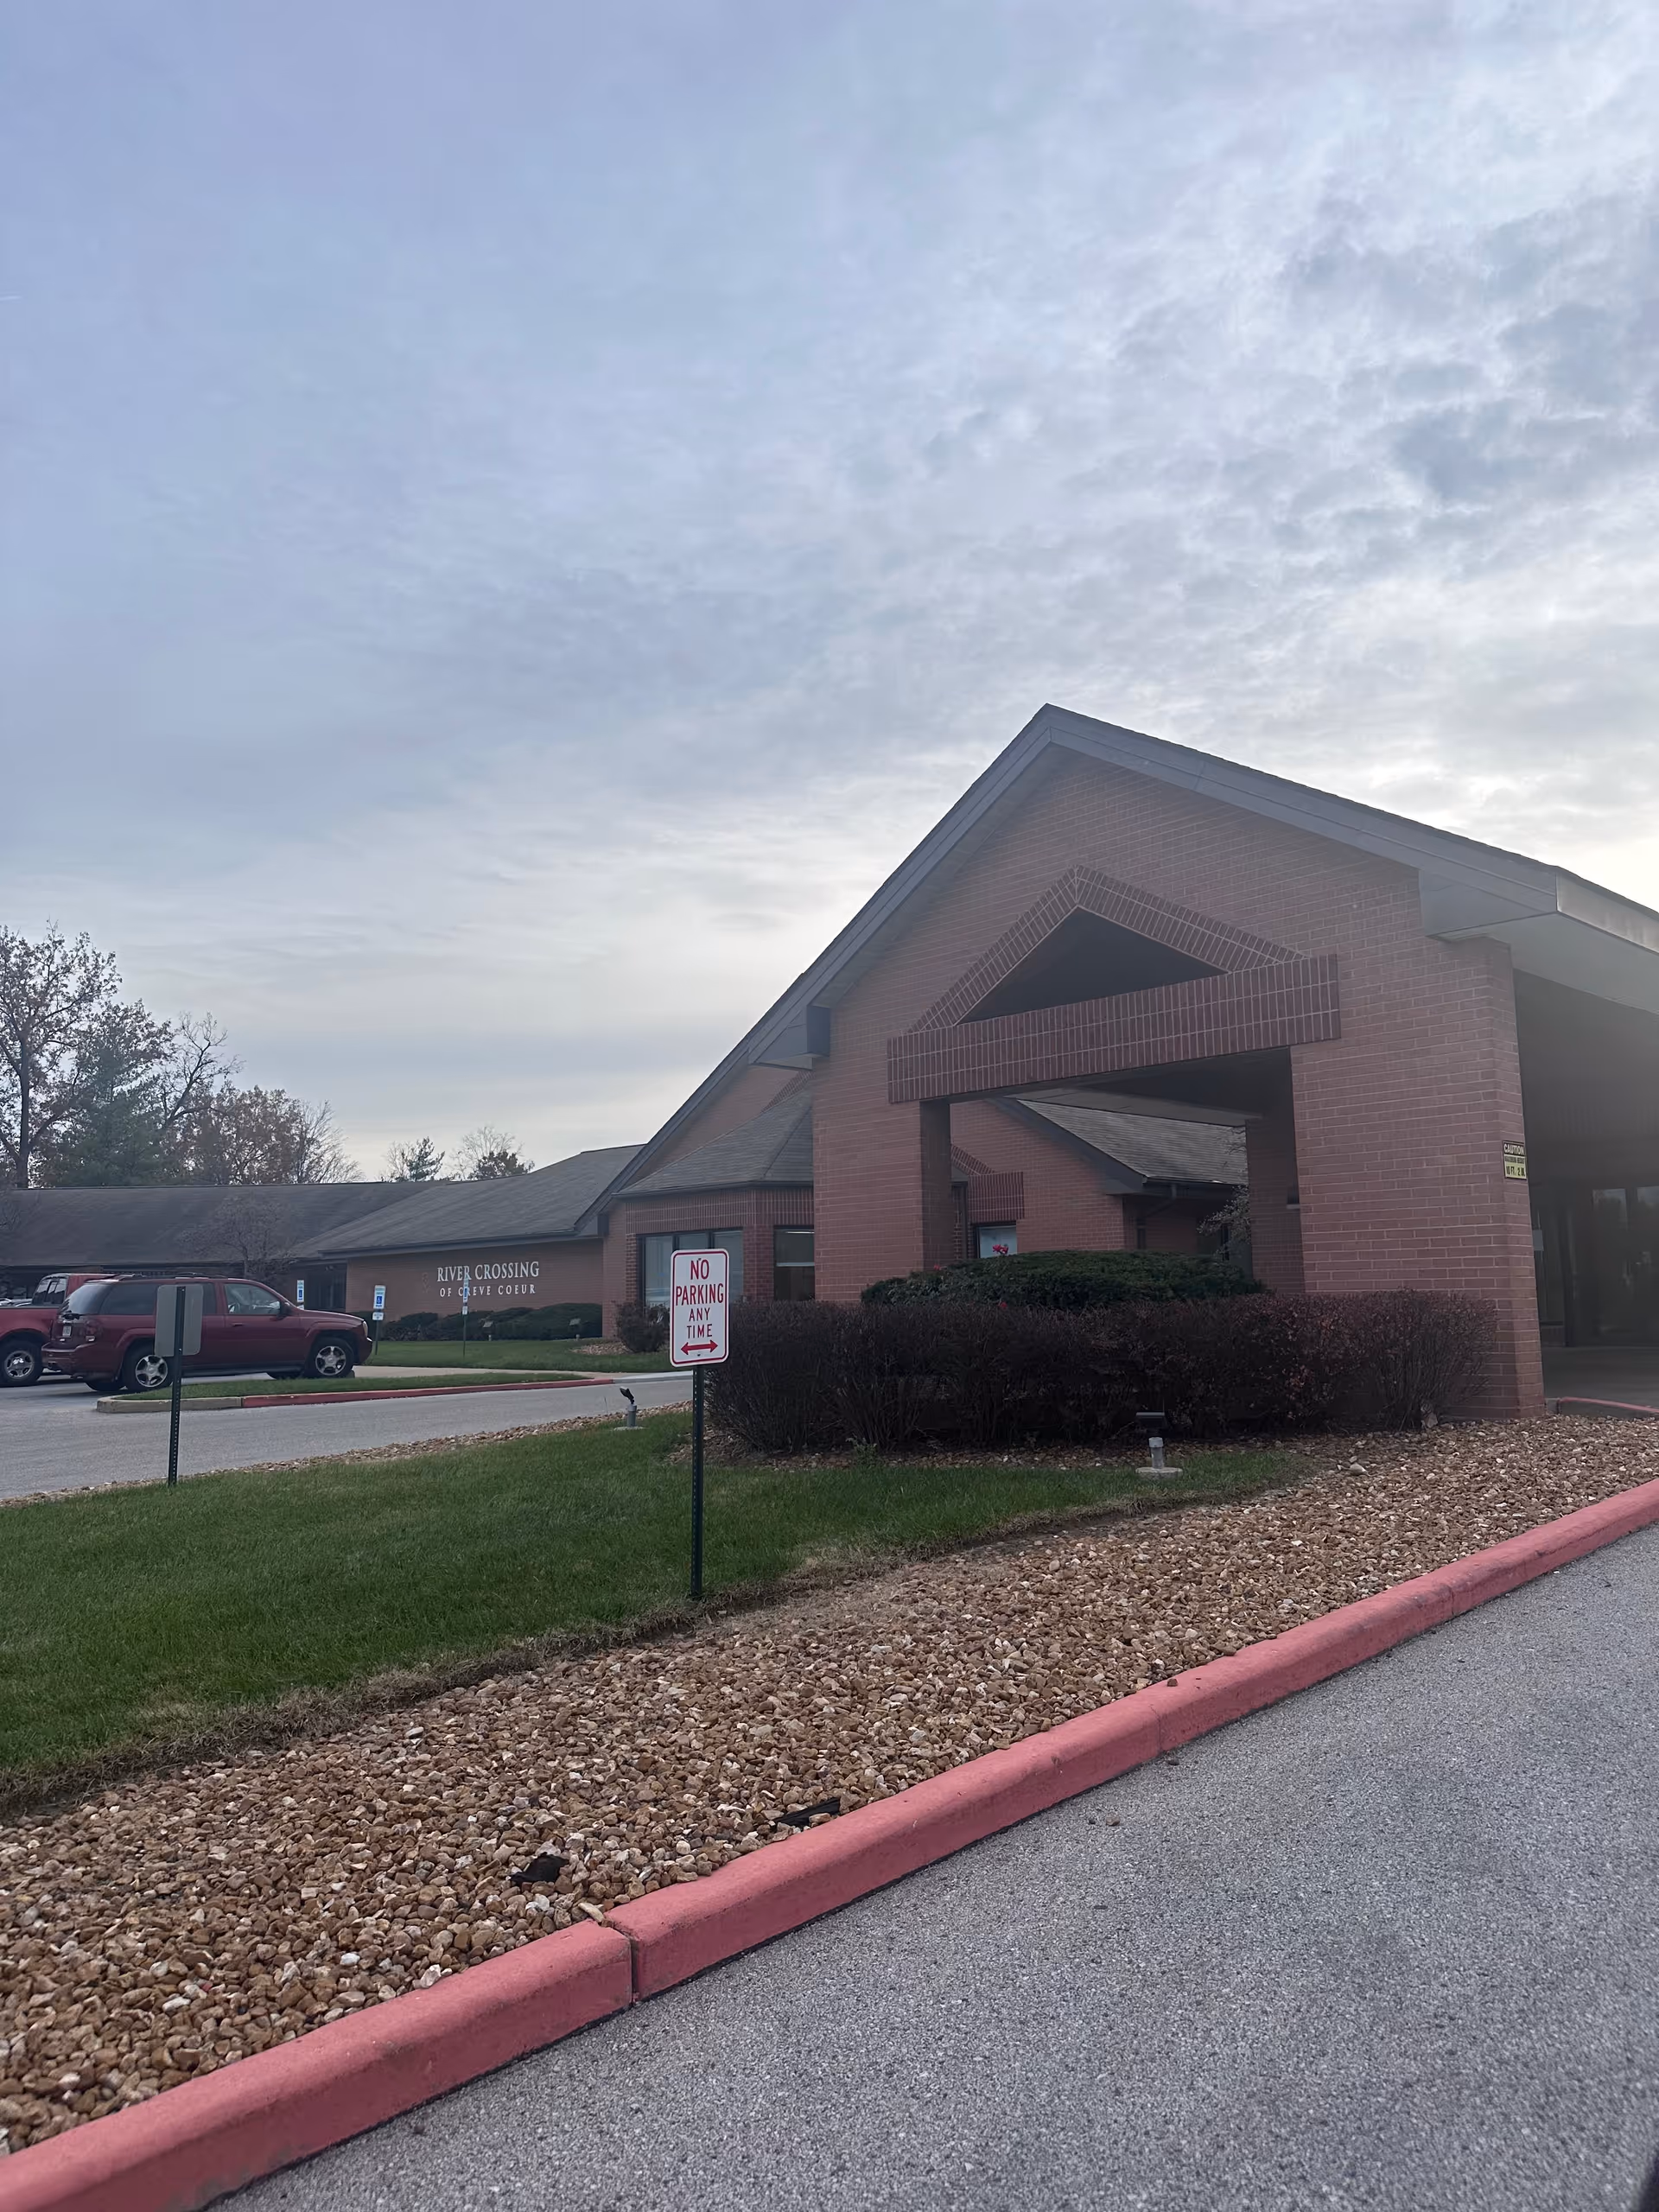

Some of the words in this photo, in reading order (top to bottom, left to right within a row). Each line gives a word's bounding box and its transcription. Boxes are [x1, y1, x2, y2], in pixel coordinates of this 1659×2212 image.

[1503, 1143, 1524, 1155] CAUTION
[436, 1265, 472, 1282] RIVER
[474, 1262, 540, 1280] CROSSING
[690, 1259, 709, 1280] NO
[440, 1287, 452, 1298] OF
[498, 1284, 536, 1295] COEUR
[675, 1283, 724, 1306] PARKING
[689, 1307, 710, 1322] ANY
[686, 1324, 713, 1339] TIME
